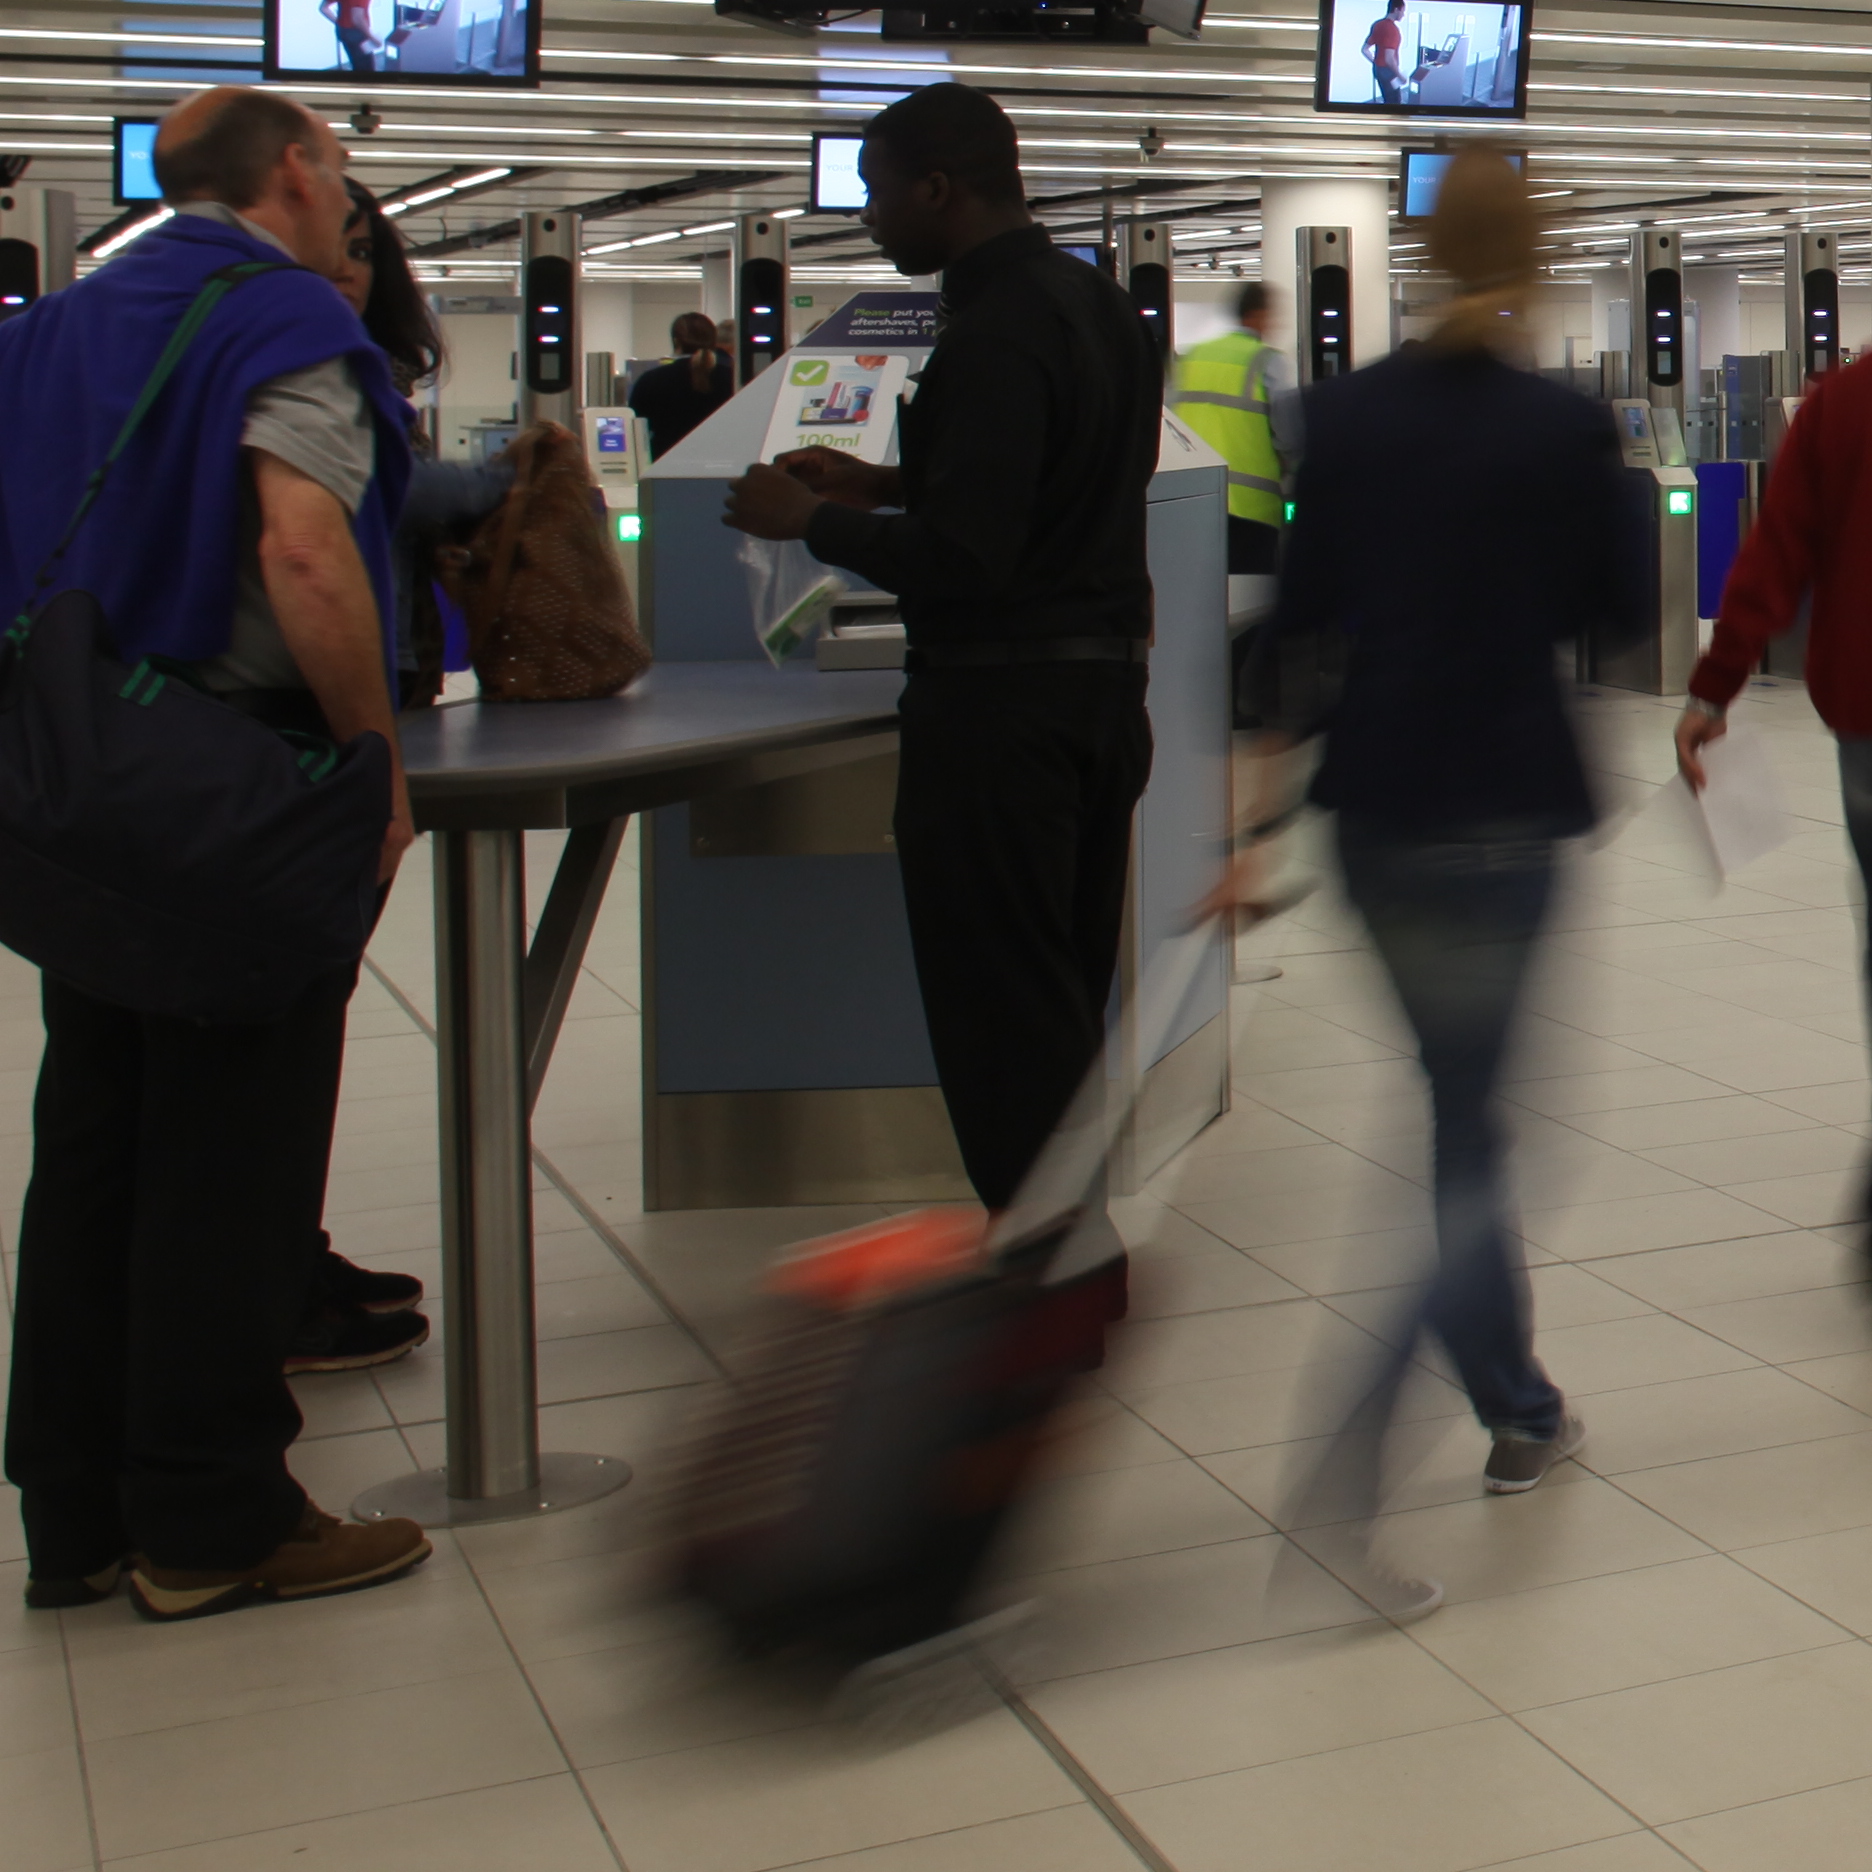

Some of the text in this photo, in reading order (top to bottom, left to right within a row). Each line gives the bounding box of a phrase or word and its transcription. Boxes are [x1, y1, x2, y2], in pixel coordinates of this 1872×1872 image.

[826, 164, 853, 172] YOUR
[854, 308, 934, 318] Please put you
[850, 318, 918, 326] aftershaves,
[848, 328, 904, 336] cosmetics
[796, 433, 861, 447] 100ml
